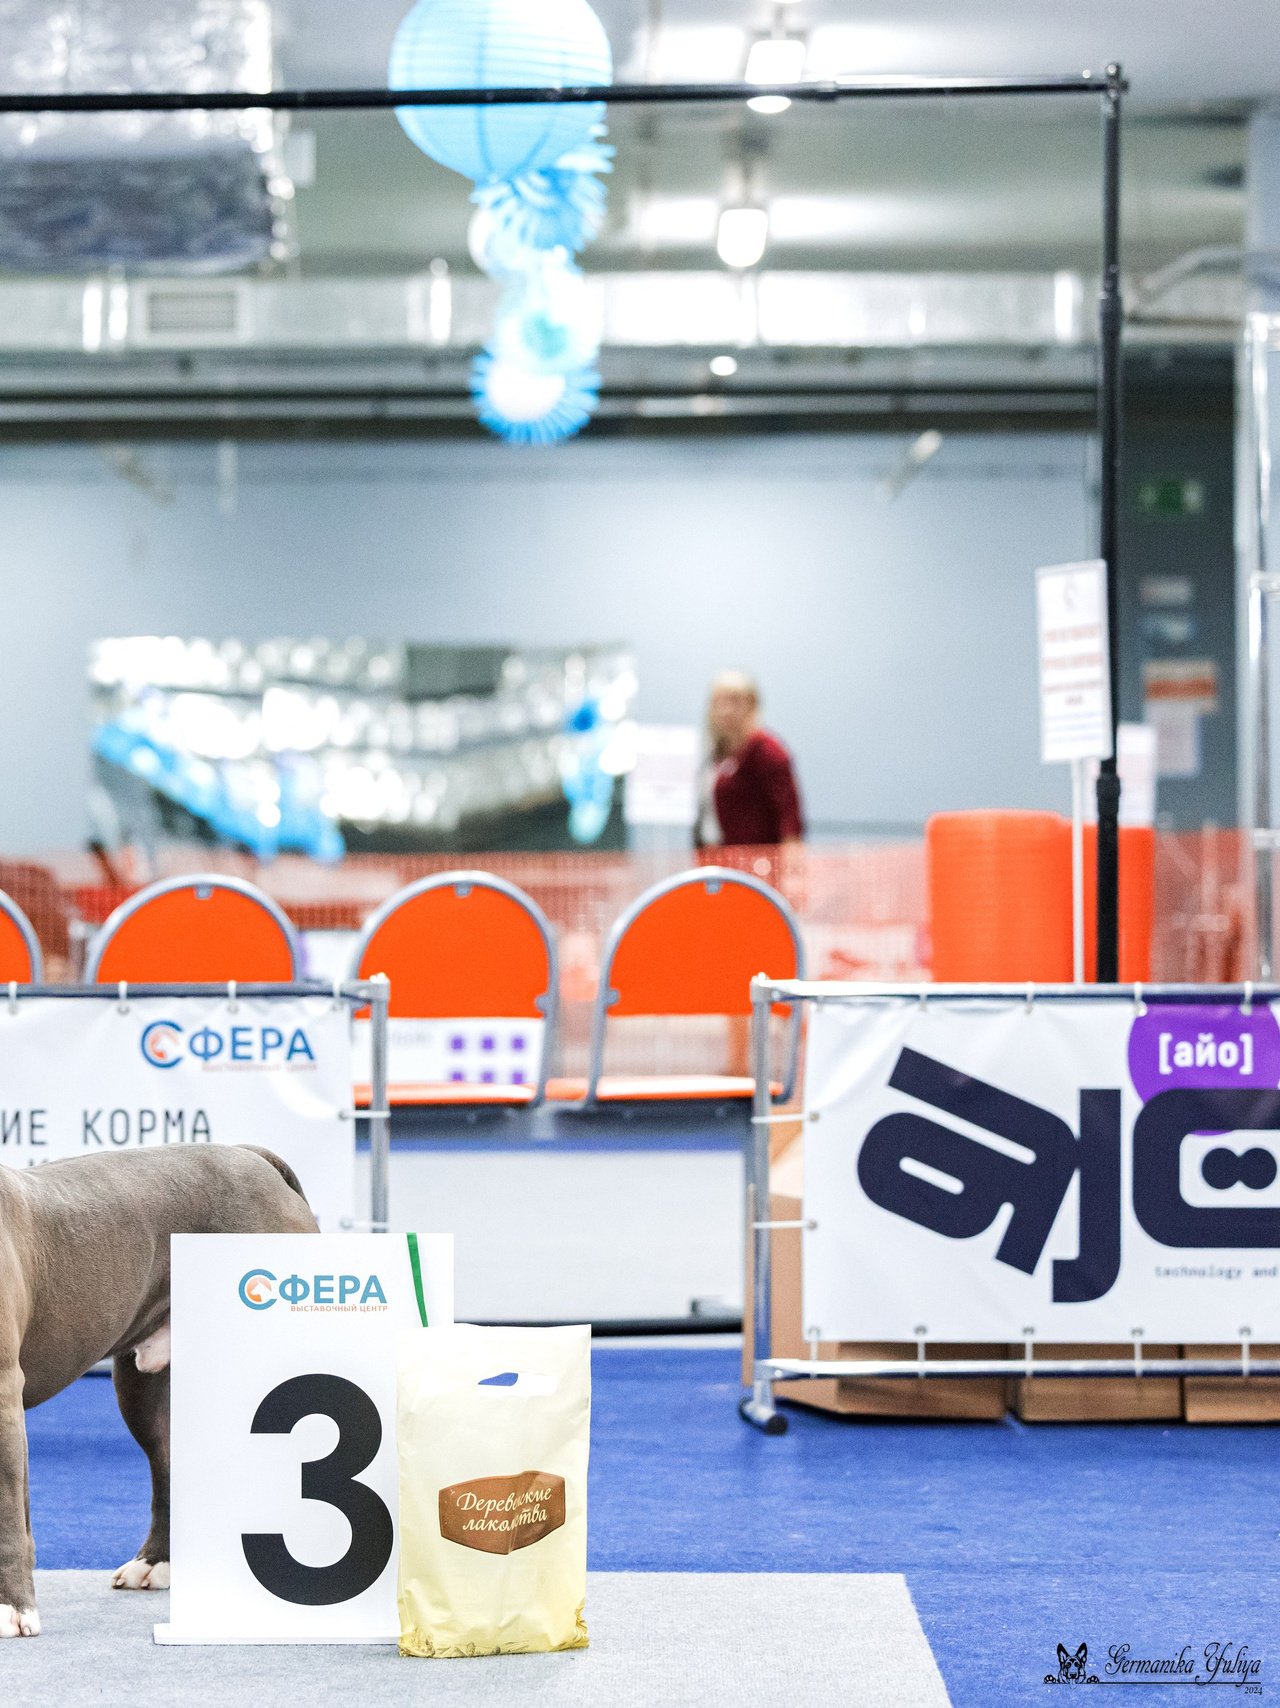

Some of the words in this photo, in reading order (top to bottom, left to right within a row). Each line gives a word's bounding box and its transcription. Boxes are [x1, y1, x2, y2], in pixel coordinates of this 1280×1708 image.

[141, 1020, 315, 1069] СФЕРА
[82, 1108, 211, 1145] КОРМА
[238, 1268, 388, 1311] СФЕРА
[290, 1304, 357, 1312] ВЫСТАВОЧНЫЙ
[359, 1305, 388, 1313] ЦЕНТР
[241, 1373, 394, 1606] 3
